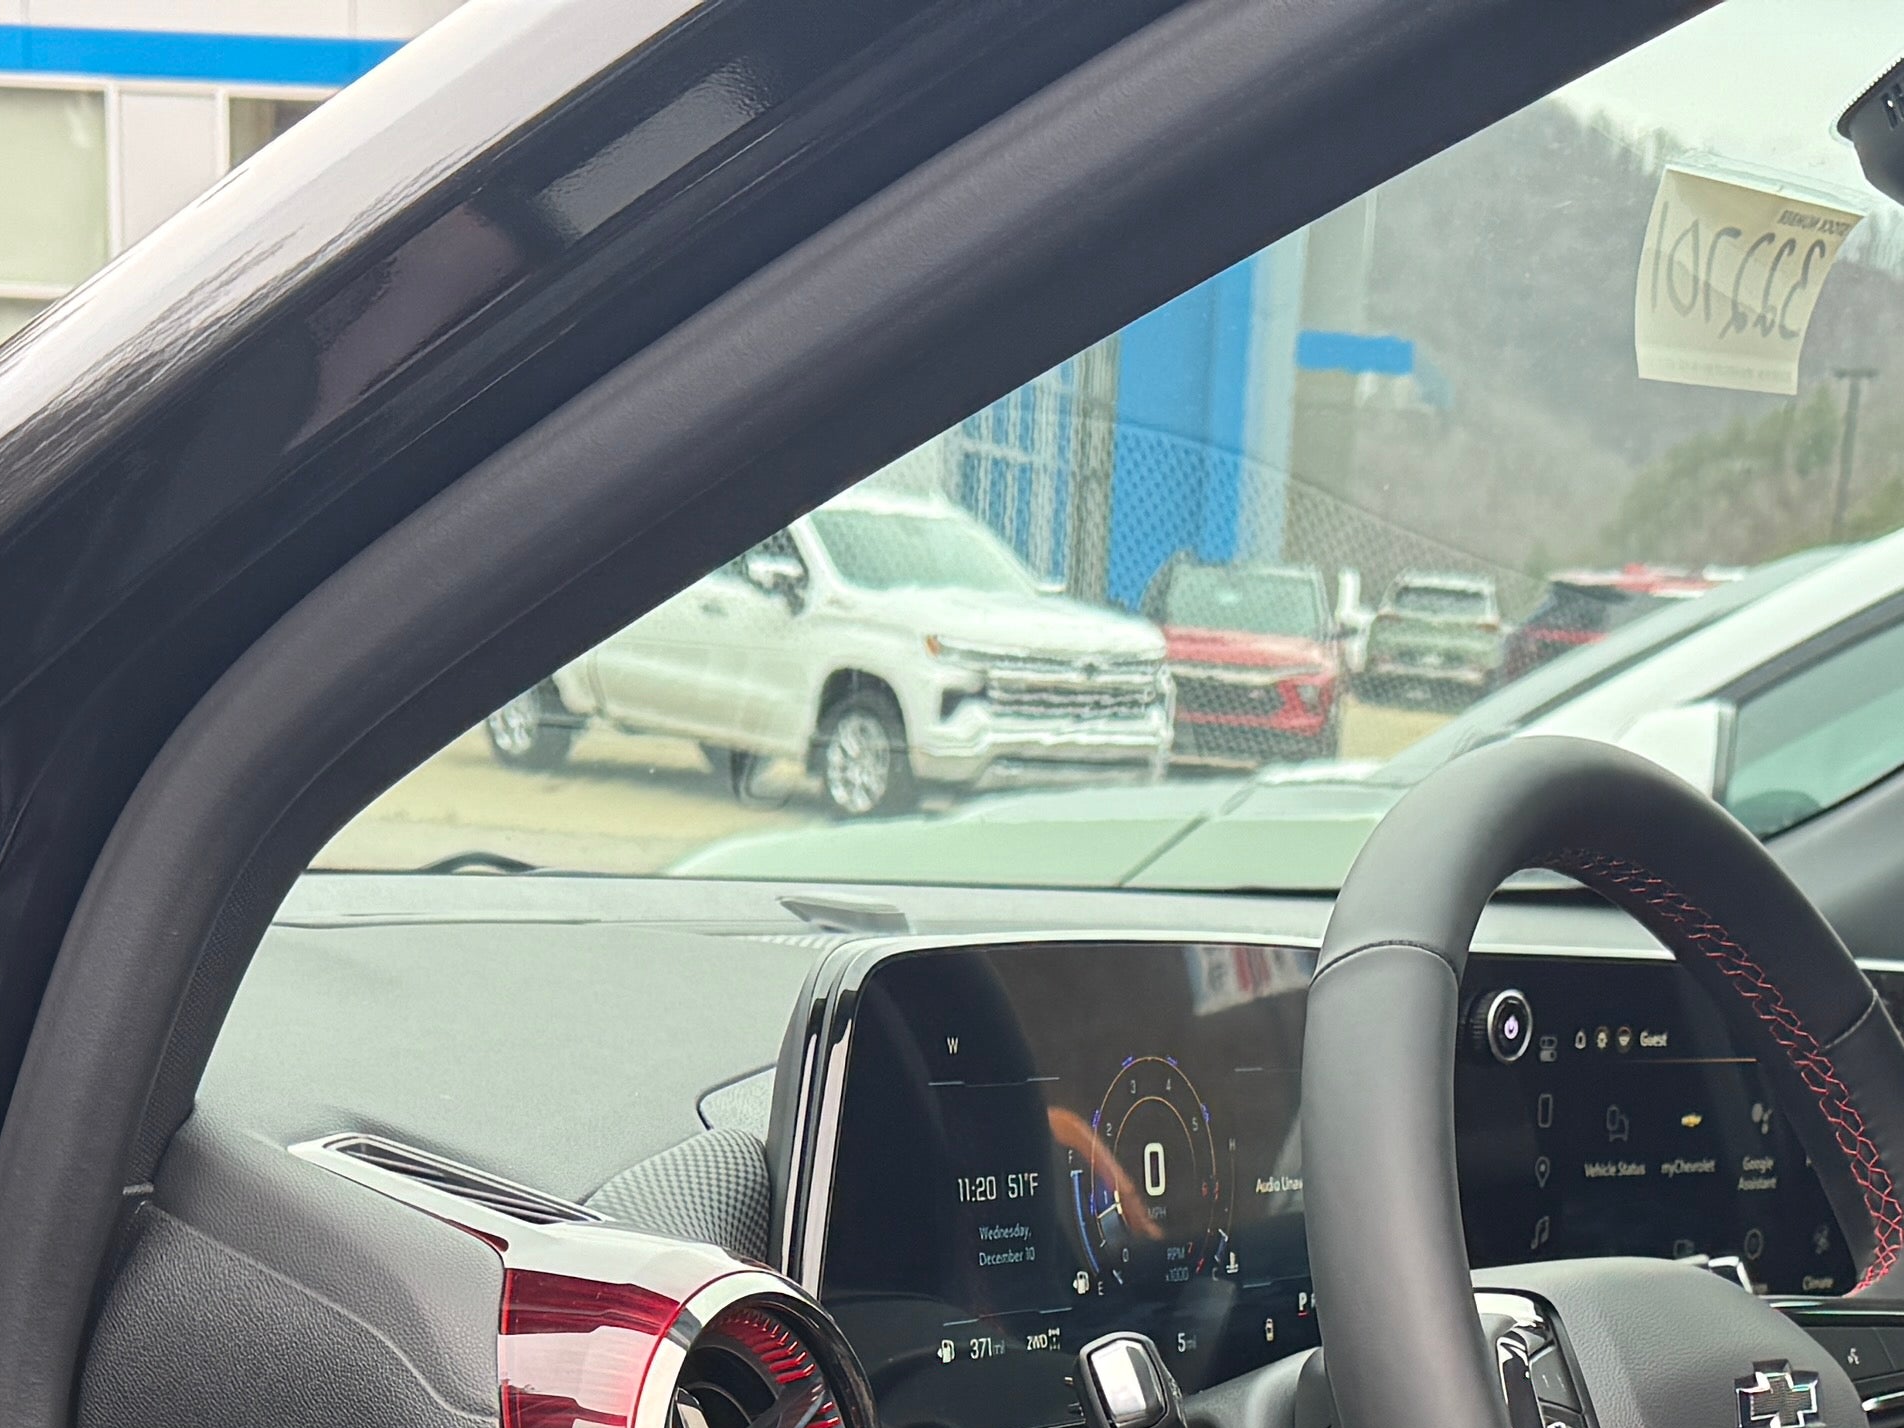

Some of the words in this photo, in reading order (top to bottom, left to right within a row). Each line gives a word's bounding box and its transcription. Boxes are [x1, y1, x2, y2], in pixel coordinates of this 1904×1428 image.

[1143, 1142, 1167, 1197] 0
[957, 1175, 997, 1202] 11:20
[978, 1248, 1024, 1267] December
